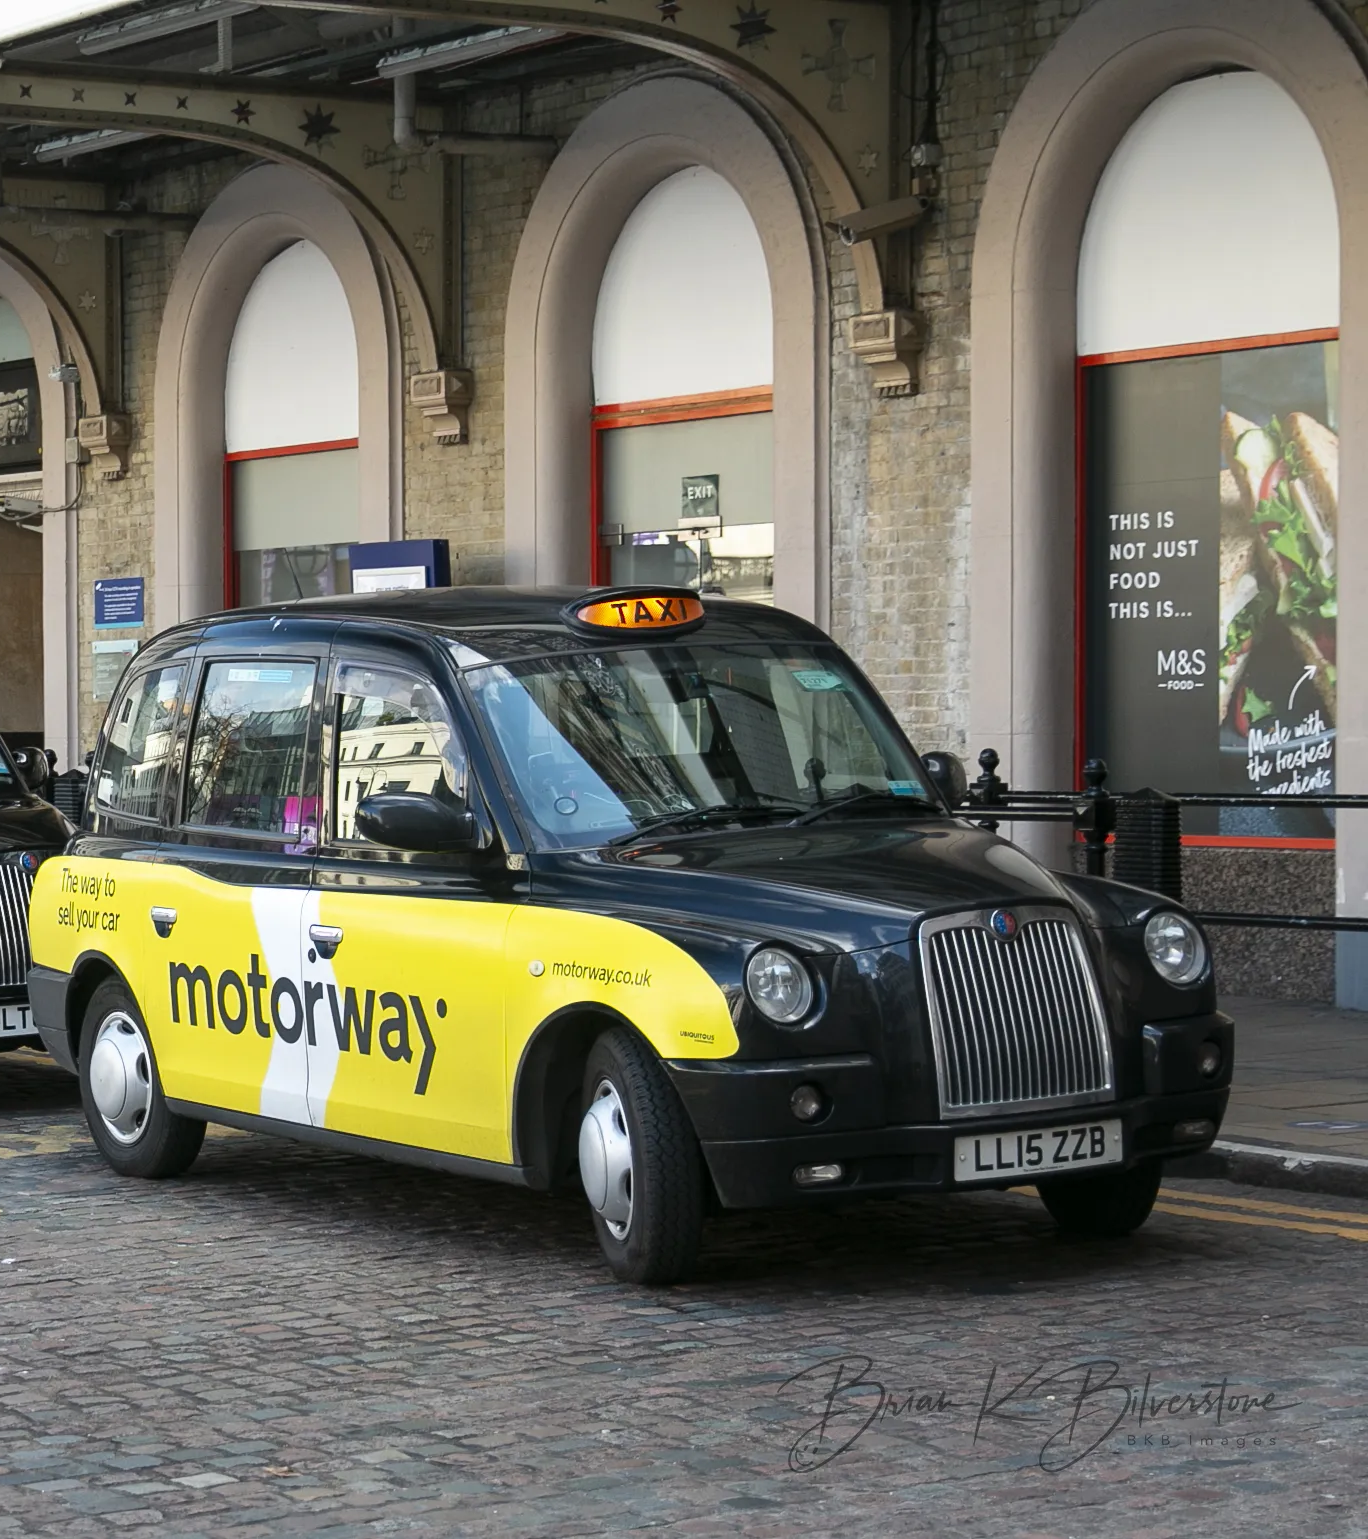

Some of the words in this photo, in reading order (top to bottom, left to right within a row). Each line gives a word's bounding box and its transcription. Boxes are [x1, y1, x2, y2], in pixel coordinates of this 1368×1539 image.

[687, 485, 713, 499] EXIT
[1109, 513, 1150, 531] THIS
[1157, 511, 1174, 528] IS
[1109, 542, 1146, 560] NOT
[1152, 540, 1199, 558] JUST
[1109, 572, 1161, 590] FOOD
[611, 599, 688, 624] TAXI
[1109, 602, 1150, 619] THIS
[1157, 601, 1192, 618] IS...
[1157, 649, 1206, 676] M&S
[1167, 680, 1194, 690] FOOD
[1248, 719, 1292, 758] Made
[1294, 709, 1326, 738] with
[1246, 755, 1273, 782] the
[1276, 737, 1332, 773] freshest
[62, 868, 79, 893] The
[81, 876, 102, 901] way
[104, 872, 116, 897] to
[58, 901, 75, 927] sell
[76, 908, 100, 933] your
[101, 911, 120, 932] car
[552, 961, 652, 988] motorway.co.uk
[2, 1006, 35, 1031] LT
[169, 953, 440, 1096] motorway
[680, 1030, 715, 1041] UBIQUITOUS
[974, 1132, 1043, 1172] LL15
[1052, 1125, 1106, 1165] ZZB
